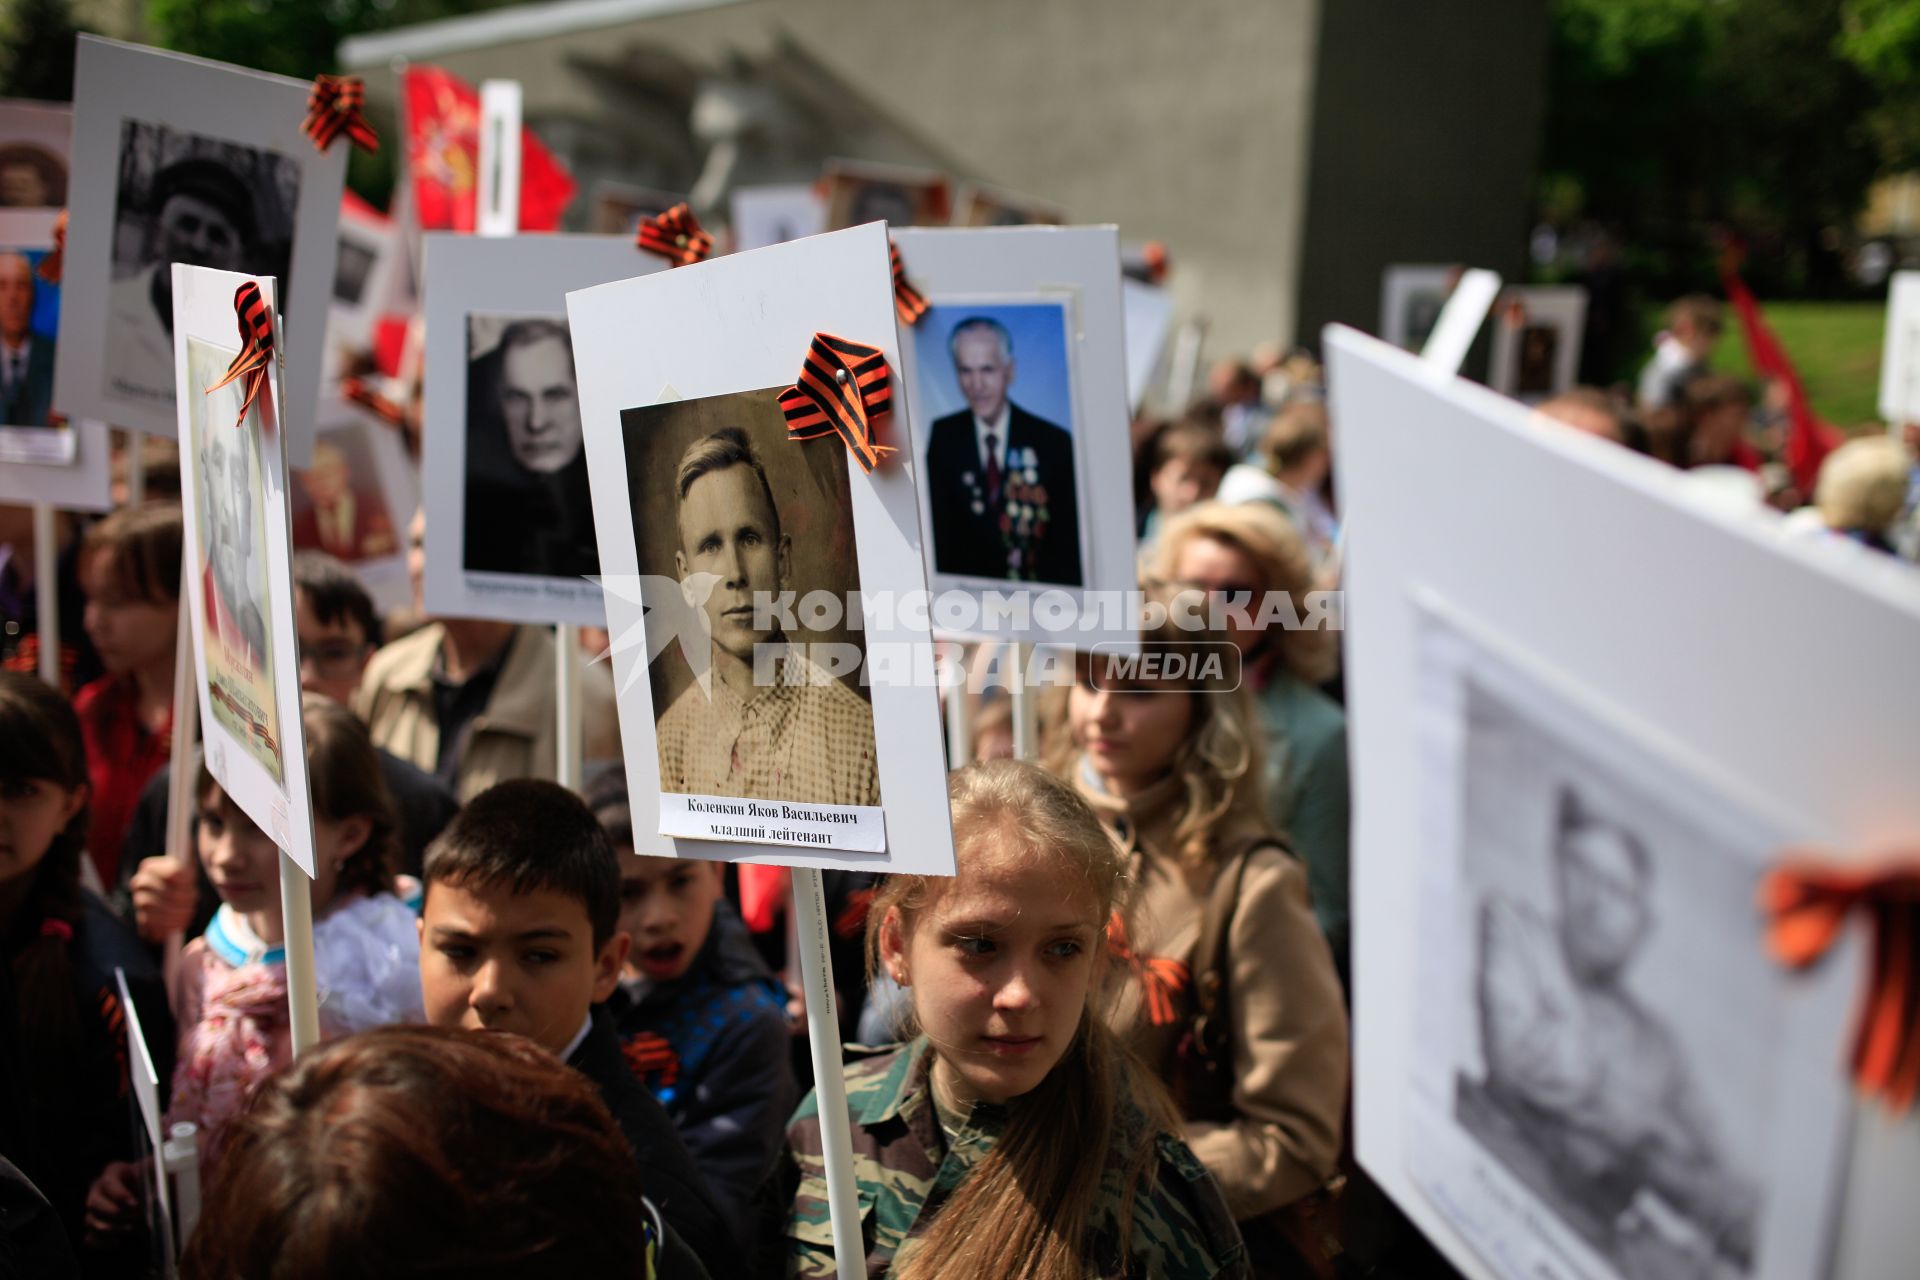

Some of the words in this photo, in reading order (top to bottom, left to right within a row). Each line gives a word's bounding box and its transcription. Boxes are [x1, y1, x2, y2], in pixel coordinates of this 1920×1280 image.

[687, 798, 745, 816] Коленкин
[748, 803, 779, 818] Яков
[782, 806, 858, 824] Васильевич
[711, 824, 765, 839] младший
[768, 828, 833, 845] лейтенант
